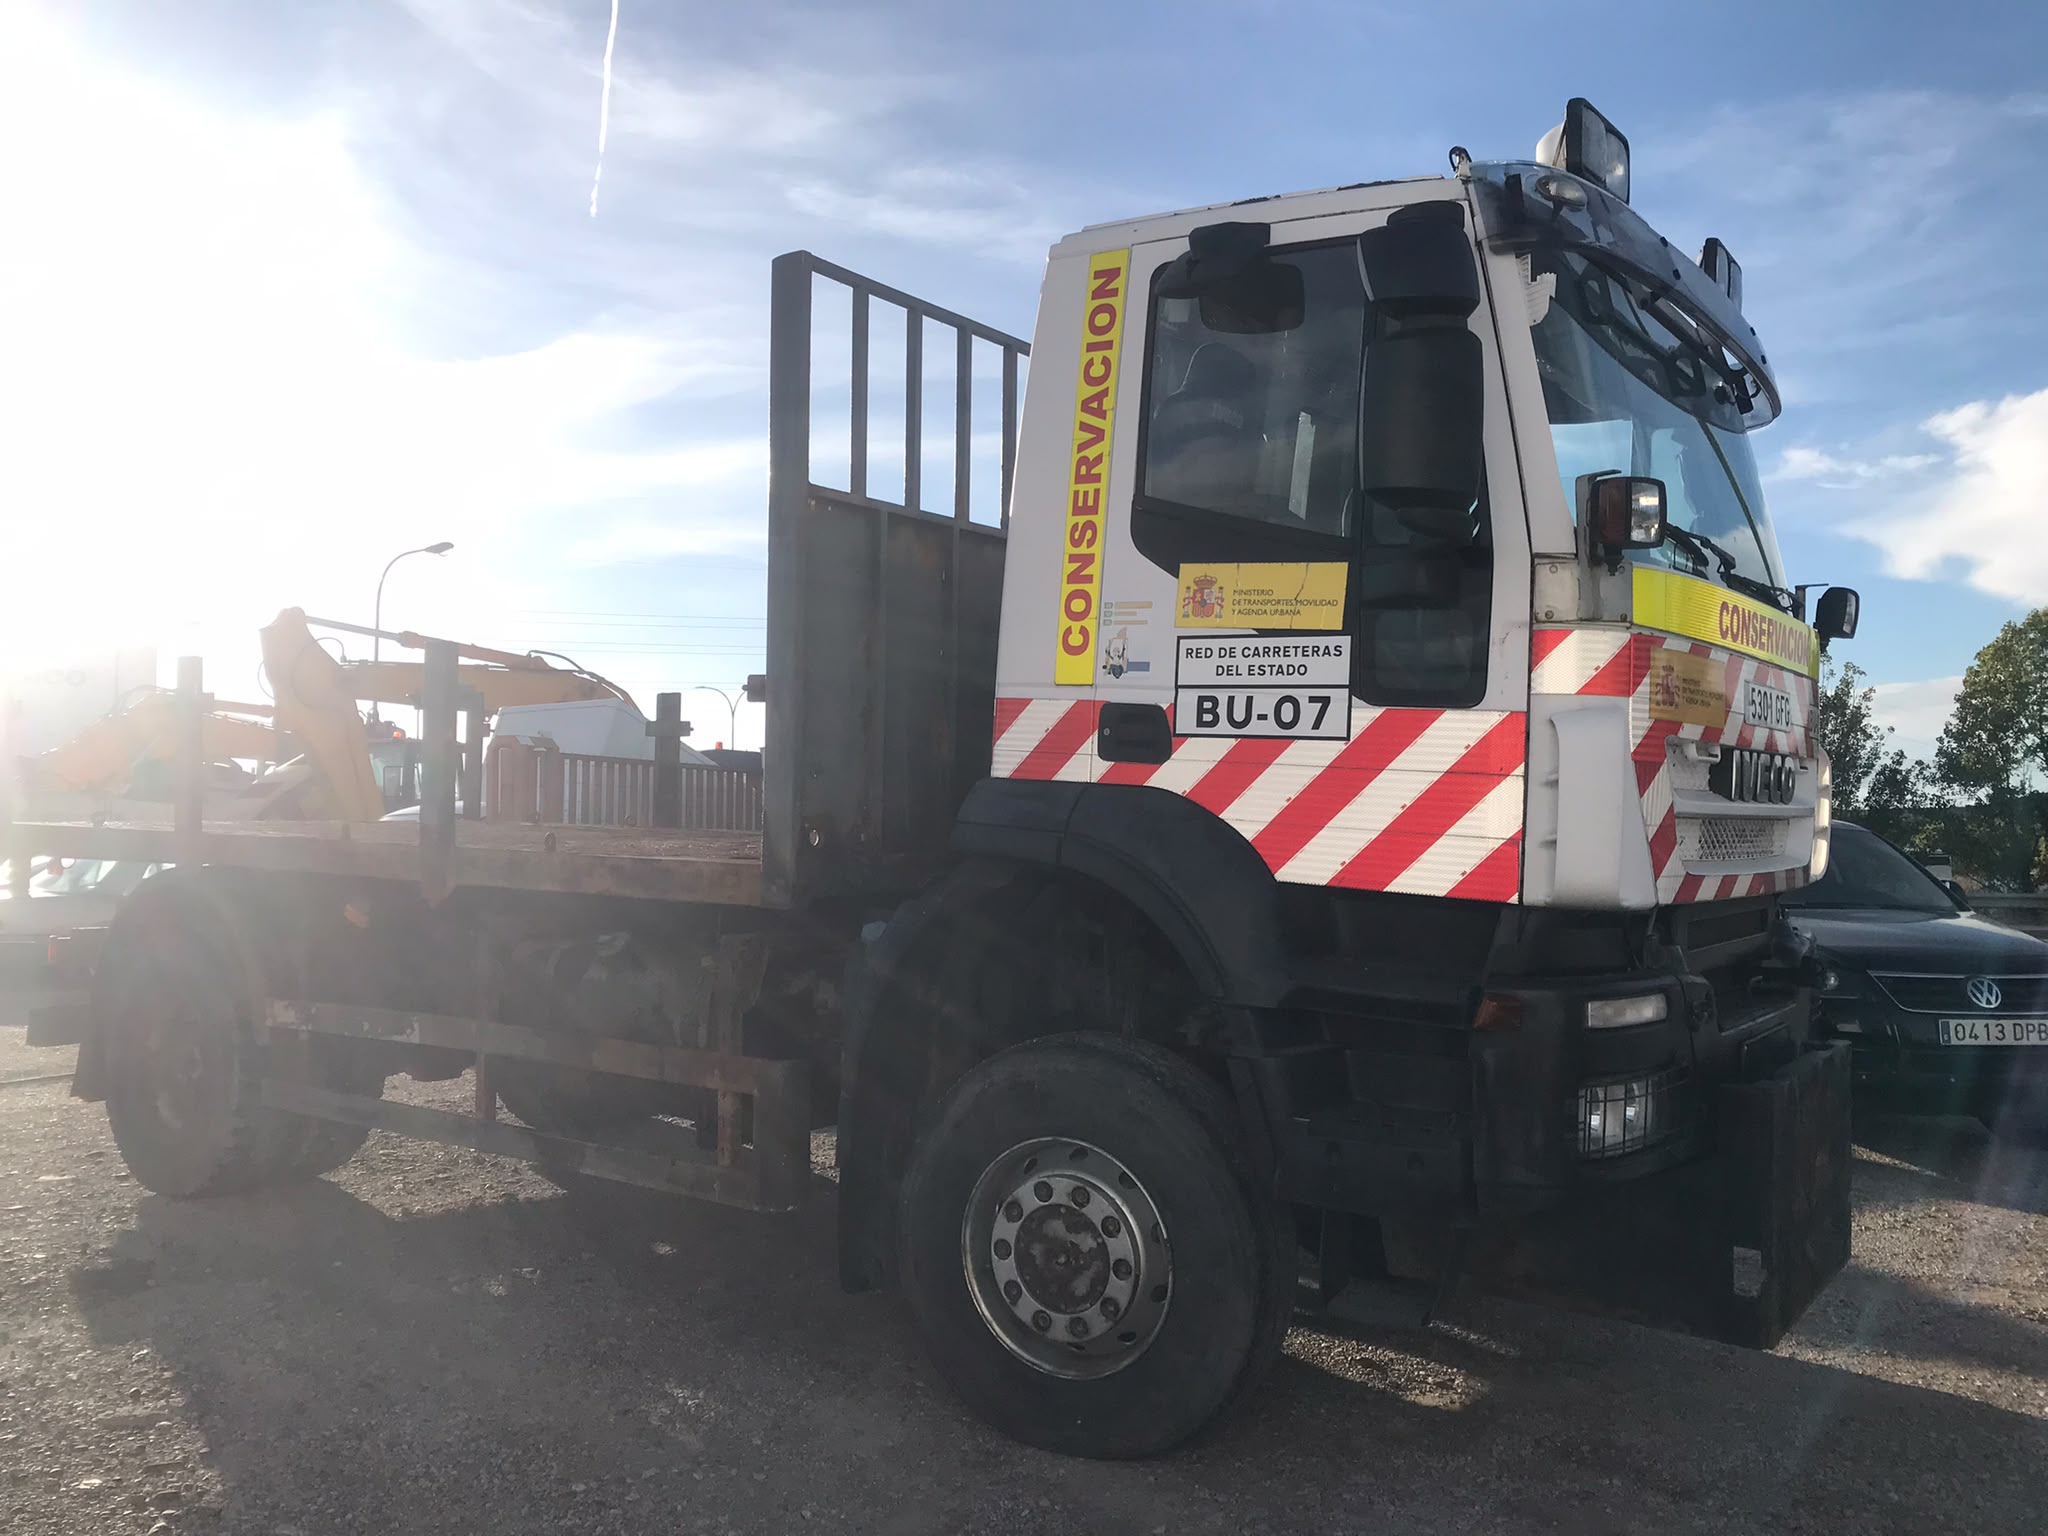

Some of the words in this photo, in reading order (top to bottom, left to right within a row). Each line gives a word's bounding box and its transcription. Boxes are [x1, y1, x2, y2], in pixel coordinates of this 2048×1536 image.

[1061, 267, 1121, 656] CONSERVACION
[1231, 598, 1242, 606] DE
[1296, 599, 1339, 607] MOVILIDAD
[1232, 589, 1274, 597] MINISTERIO
[1237, 608, 1268, 616] AGENDA
[1269, 608, 1302, 616] URBANA
[1718, 601, 1809, 667] CONSERVACION
[1185, 647, 1214, 659] RED
[1218, 646, 1237, 659] DE
[1241, 645, 1343, 659] CARRETERAS
[1215, 665, 1243, 676] DEL
[1247, 664, 1308, 676] ESTADO
[1196, 694, 1331, 730] BU-07
[1750, 687, 1773, 725] 5301
[1775, 694, 1790, 727] GFG
[1731, 749, 1796, 805] IVECO
[1954, 1023, 2007, 1042] 0413
[2012, 1023, 2048, 1041] DPB
